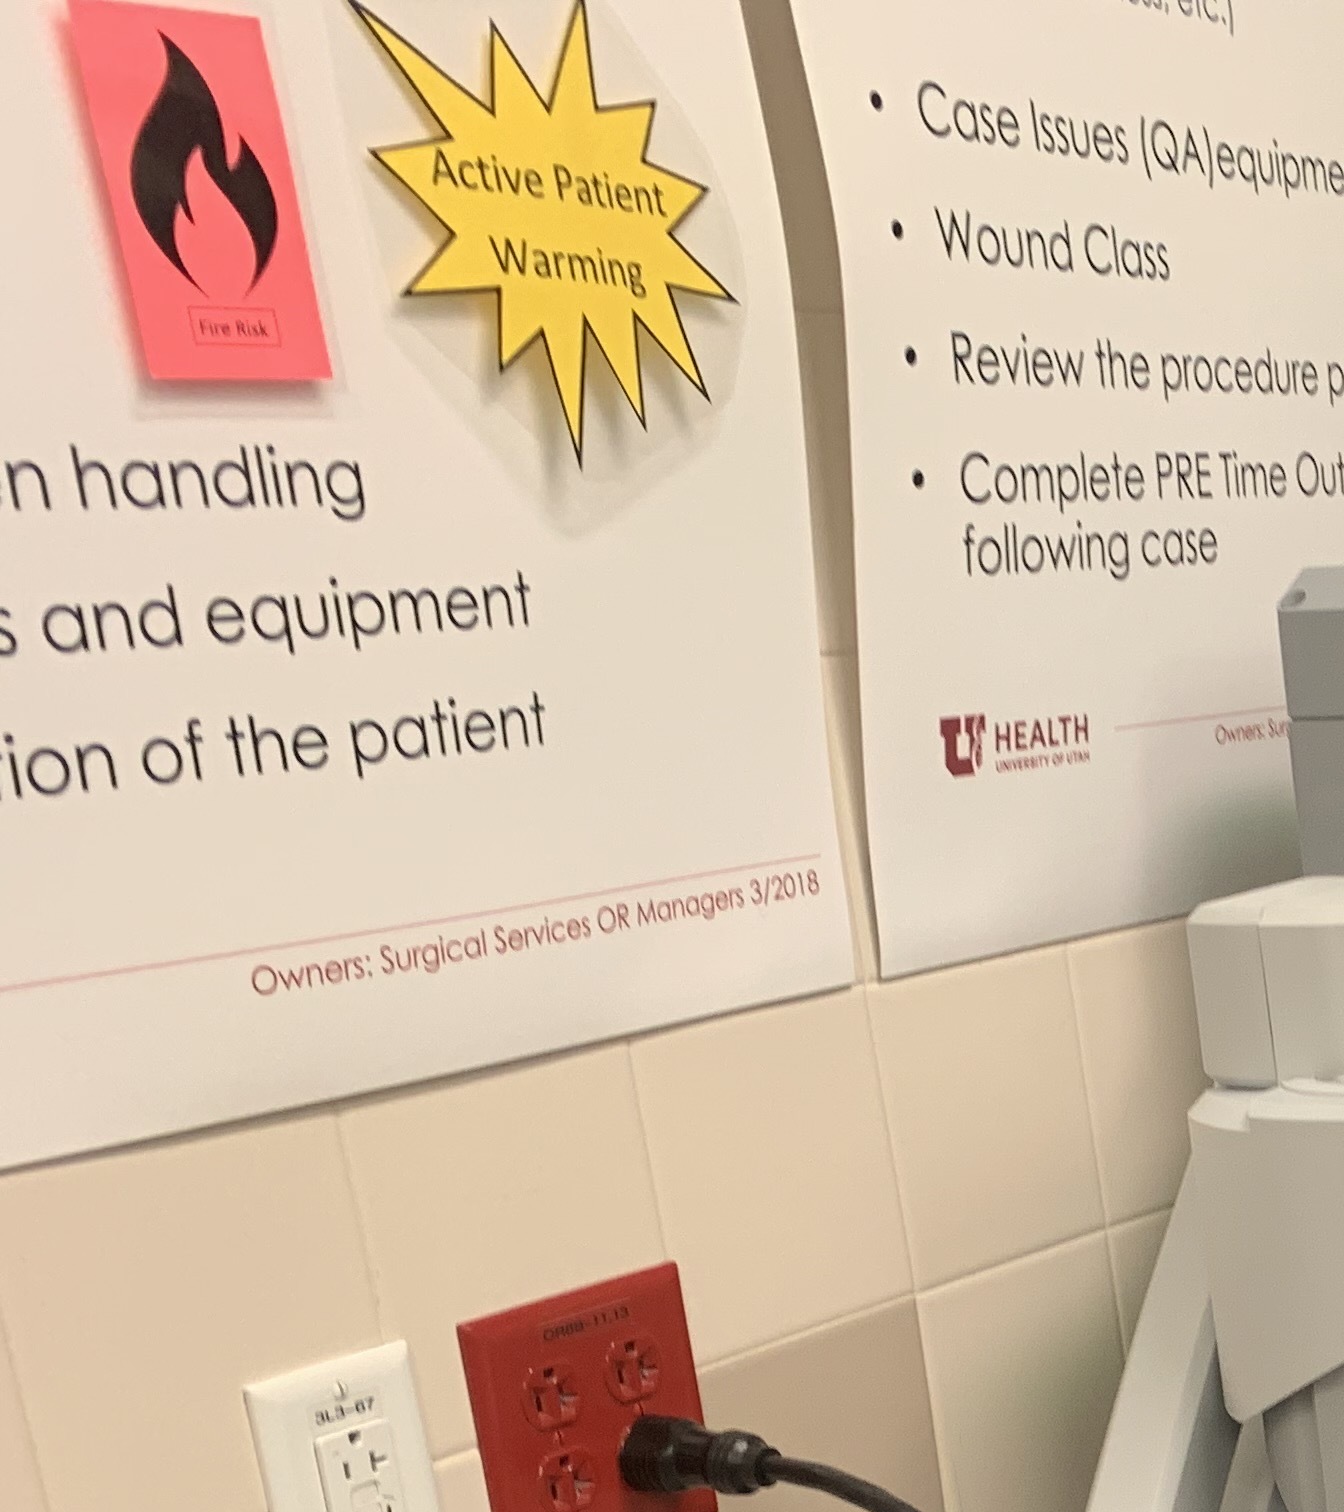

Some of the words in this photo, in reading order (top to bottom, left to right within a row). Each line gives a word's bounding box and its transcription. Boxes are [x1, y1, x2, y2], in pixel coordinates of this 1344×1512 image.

[917, 80, 1021, 149] Case
[1029, 98, 1131, 165] Issues
[432, 147, 545, 199] Active
[553, 163, 668, 218] Patient
[489, 235, 648, 299] Warming
[934, 206, 1074, 273] Wound
[1083, 222, 1171, 282] Class
[199, 319, 231, 337] Fire
[236, 319, 269, 337] Risk
[950, 330, 1084, 389] Review
[1095, 338, 1151, 391] the
[1162, 348, 1319, 403] procedure
[0, 461, 51, 512] n
[70, 443, 367, 521] handling
[959, 450, 1146, 514] Complete
[1155, 452, 1213, 500] PRE
[1217, 450, 1288, 499] Time
[964, 520, 1130, 580] following
[1141, 524, 1218, 567] case
[43, 584, 185, 655] and
[206, 570, 533, 654] equipment
[0, 733, 118, 800] ion
[142, 720, 205, 786] of
[225, 716, 330, 778] the
[350, 691, 548, 778] patient
[994, 713, 1089, 753] HEALTH
[995, 755, 1050, 774] UNIVERSITY
[1052, 752, 1065, 768] OF
[1066, 750, 1091, 766] UTAH
[251, 948, 374, 998] Owners:
[379, 927, 489, 978] Surgical
[494, 913, 593, 953] Services
[596, 905, 632, 935] OR
[636, 884, 746, 930] Managers
[749, 868, 821, 908] 3/2018
